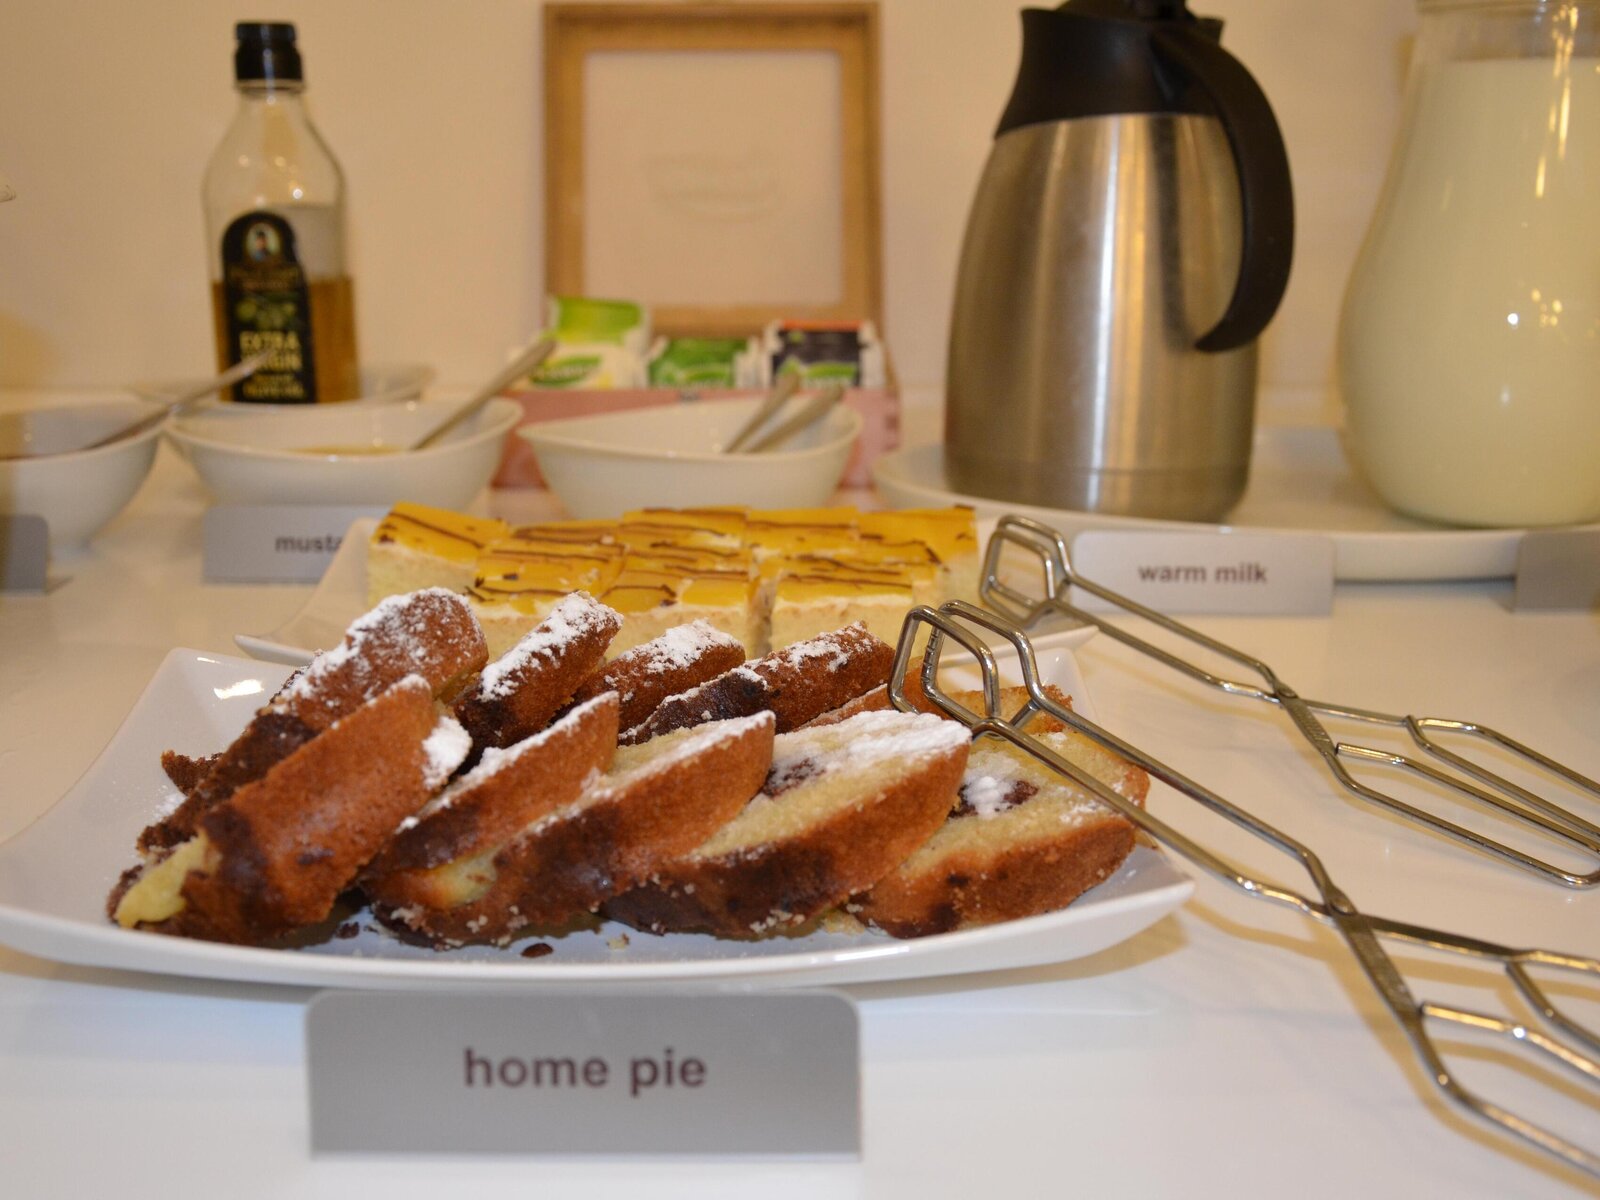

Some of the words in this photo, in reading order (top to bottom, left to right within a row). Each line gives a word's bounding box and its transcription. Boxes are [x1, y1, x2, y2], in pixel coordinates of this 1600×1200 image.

[1139, 566, 1207, 583] warm
[1216, 563, 1267, 583] milk
[464, 1047, 608, 1088] home
[630, 1047, 707, 1097] pie
